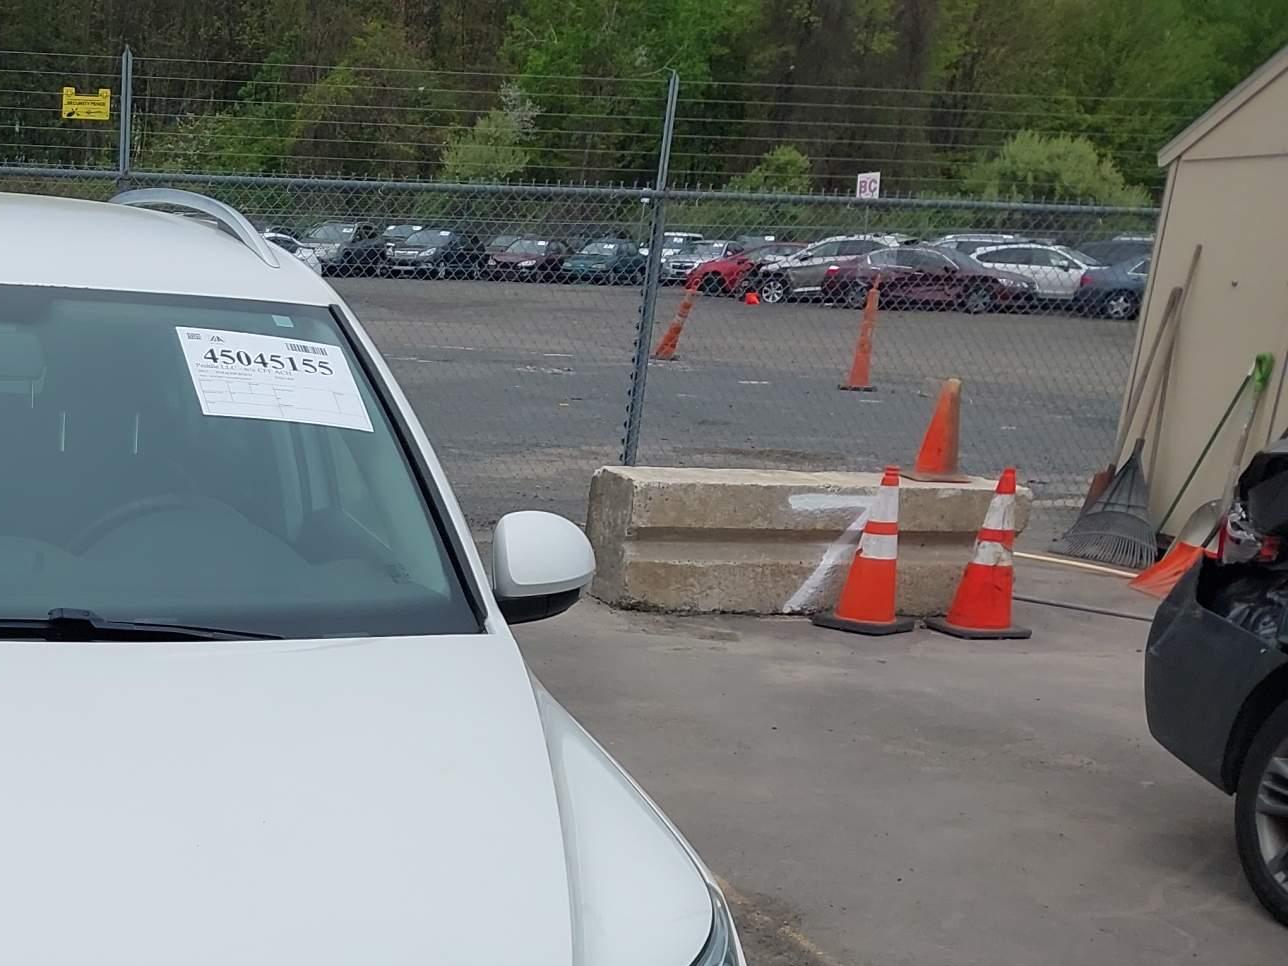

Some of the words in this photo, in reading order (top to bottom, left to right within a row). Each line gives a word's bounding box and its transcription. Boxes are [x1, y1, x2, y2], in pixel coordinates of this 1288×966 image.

[859, 179, 878, 194] BC
[203, 348, 333, 375] 45045155
[782, 493, 879, 614] 7
